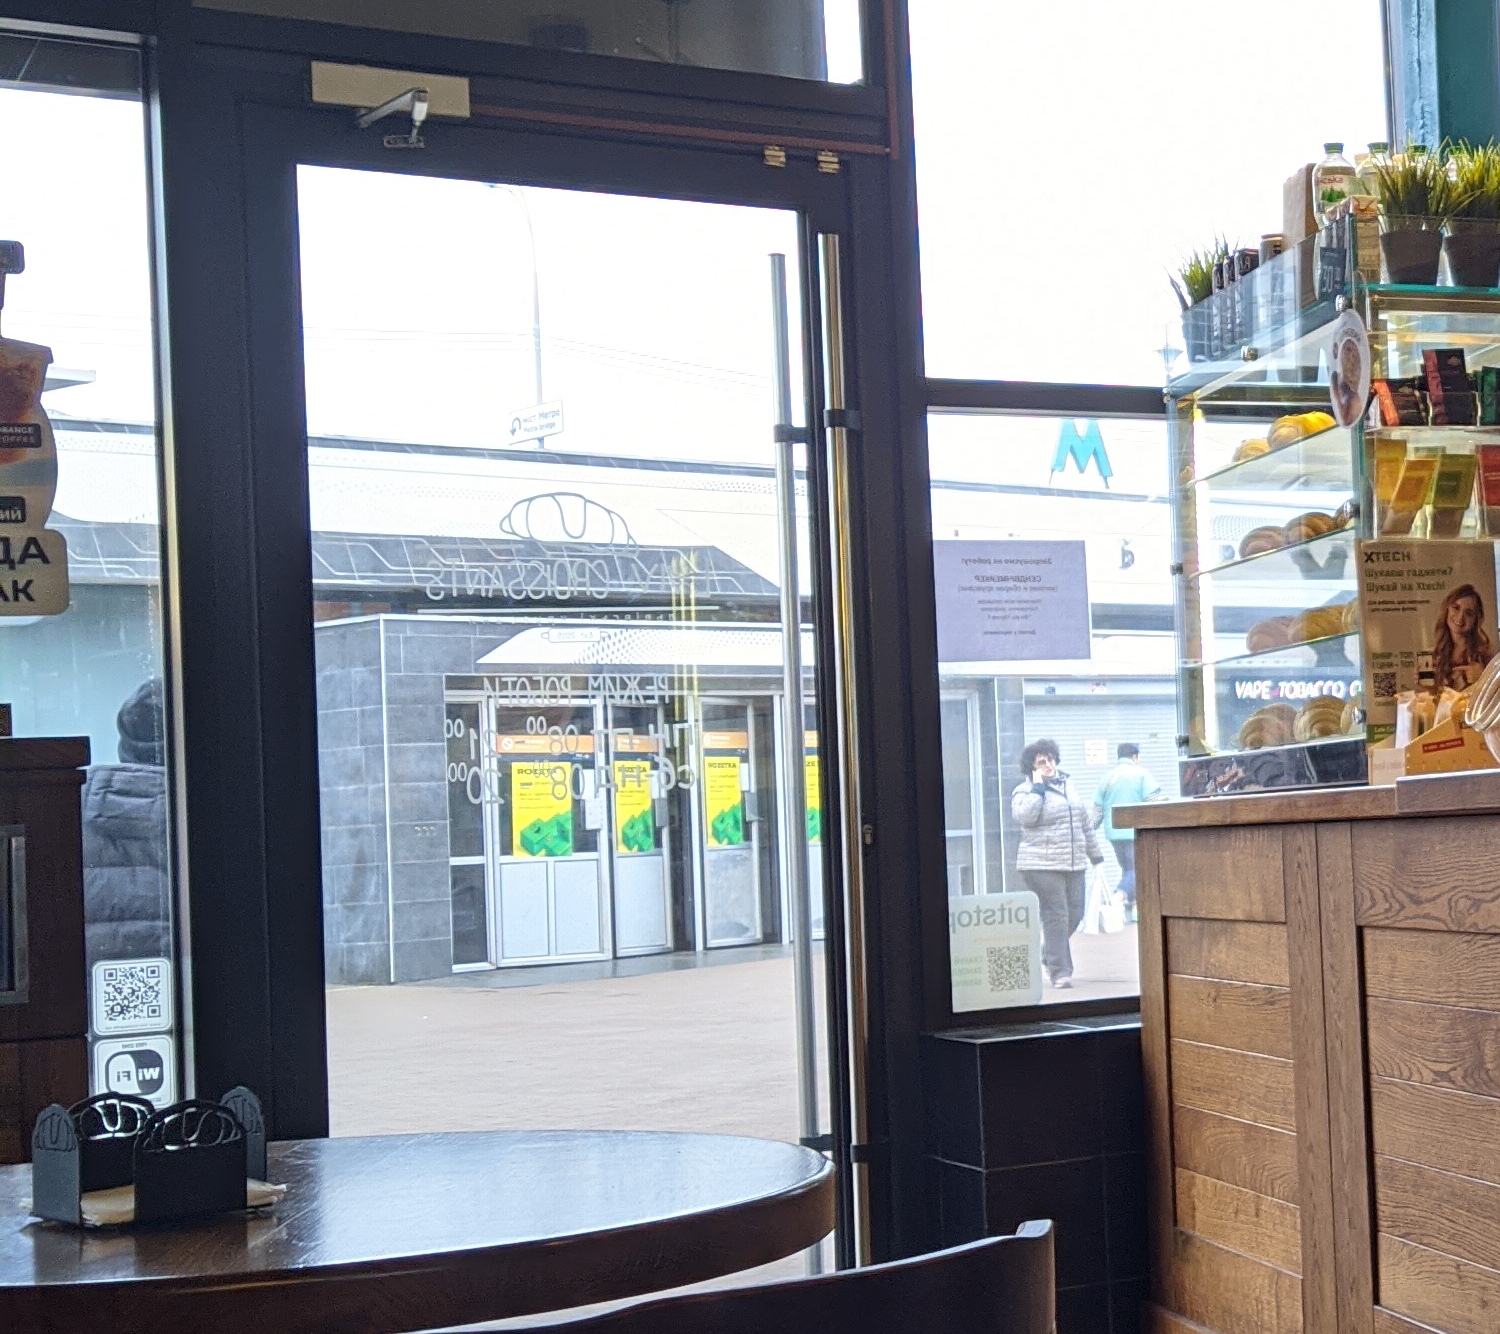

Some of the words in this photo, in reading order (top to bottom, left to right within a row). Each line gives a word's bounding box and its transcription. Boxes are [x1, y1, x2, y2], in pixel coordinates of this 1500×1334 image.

[0, 536, 51, 571] ДА
[1364, 551, 1412, 564] XTECH
[1235, 680, 1273, 700] VAPE
[1278, 680, 1345, 700] TOBACCO
